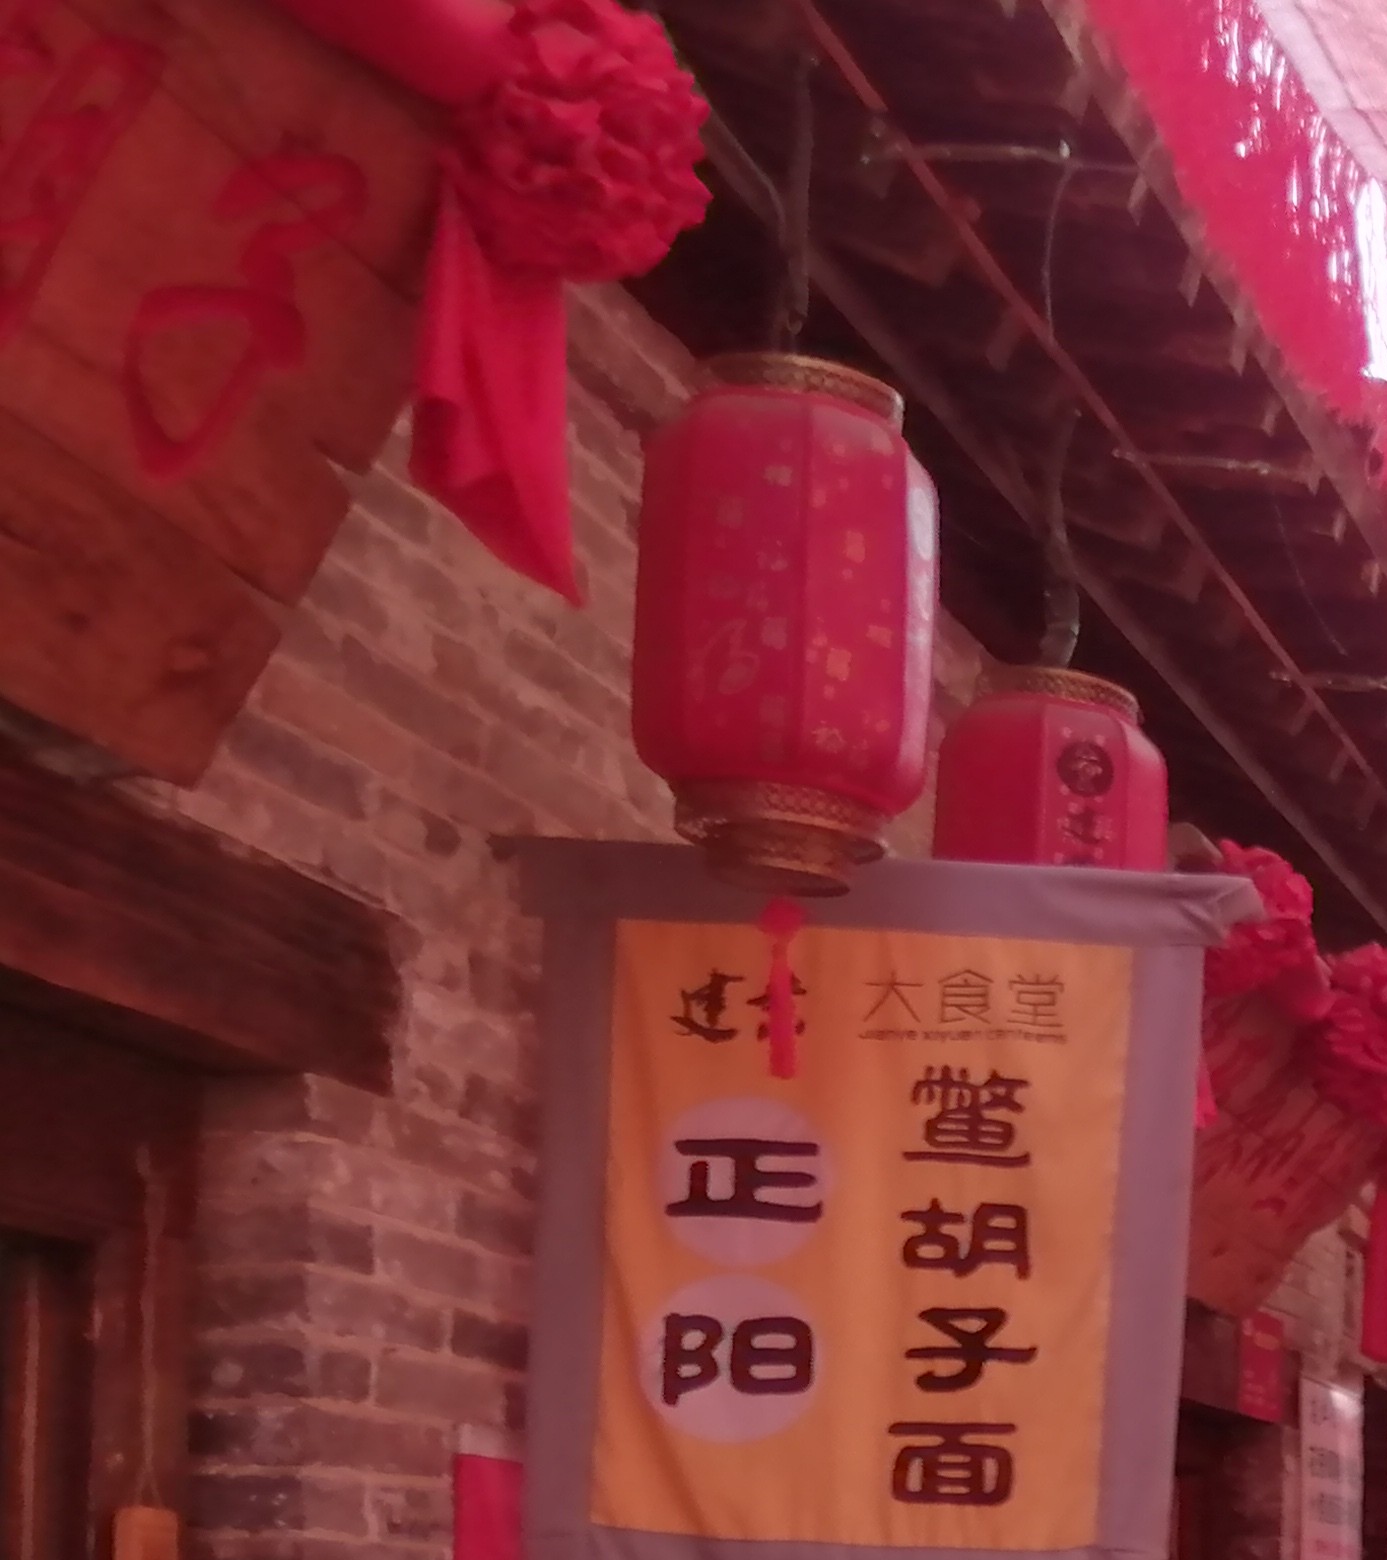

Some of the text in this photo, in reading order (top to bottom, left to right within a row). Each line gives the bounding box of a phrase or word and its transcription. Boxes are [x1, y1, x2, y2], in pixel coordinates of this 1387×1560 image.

[864, 969, 1065, 1028] 大食堂
[660, 1138, 823, 1407] 正阳
